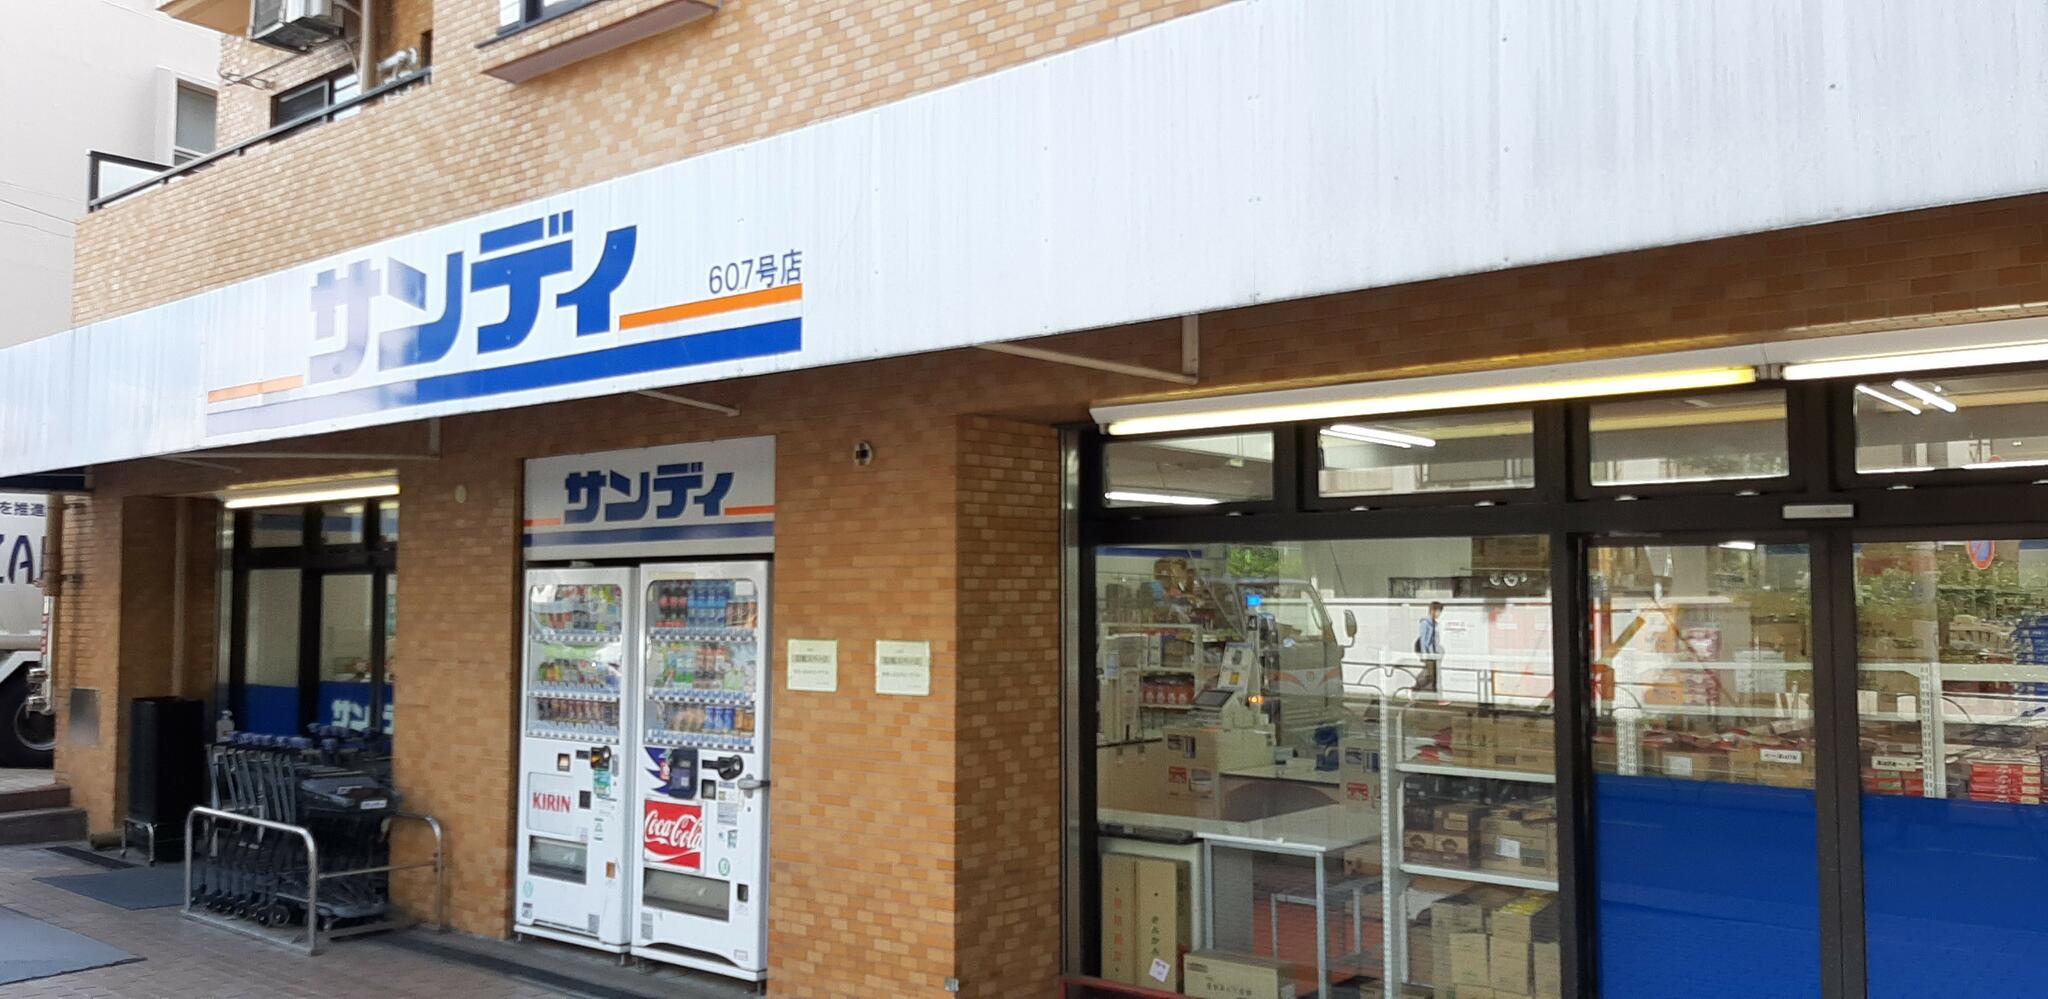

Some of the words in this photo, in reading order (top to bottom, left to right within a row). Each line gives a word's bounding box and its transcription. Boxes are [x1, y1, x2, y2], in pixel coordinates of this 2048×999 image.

[309, 210, 637, 385] サンディ
[709, 249, 802, 294] 607号店
[565, 461, 735, 525] サンディ
[532, 791, 572, 814] KIRIN
